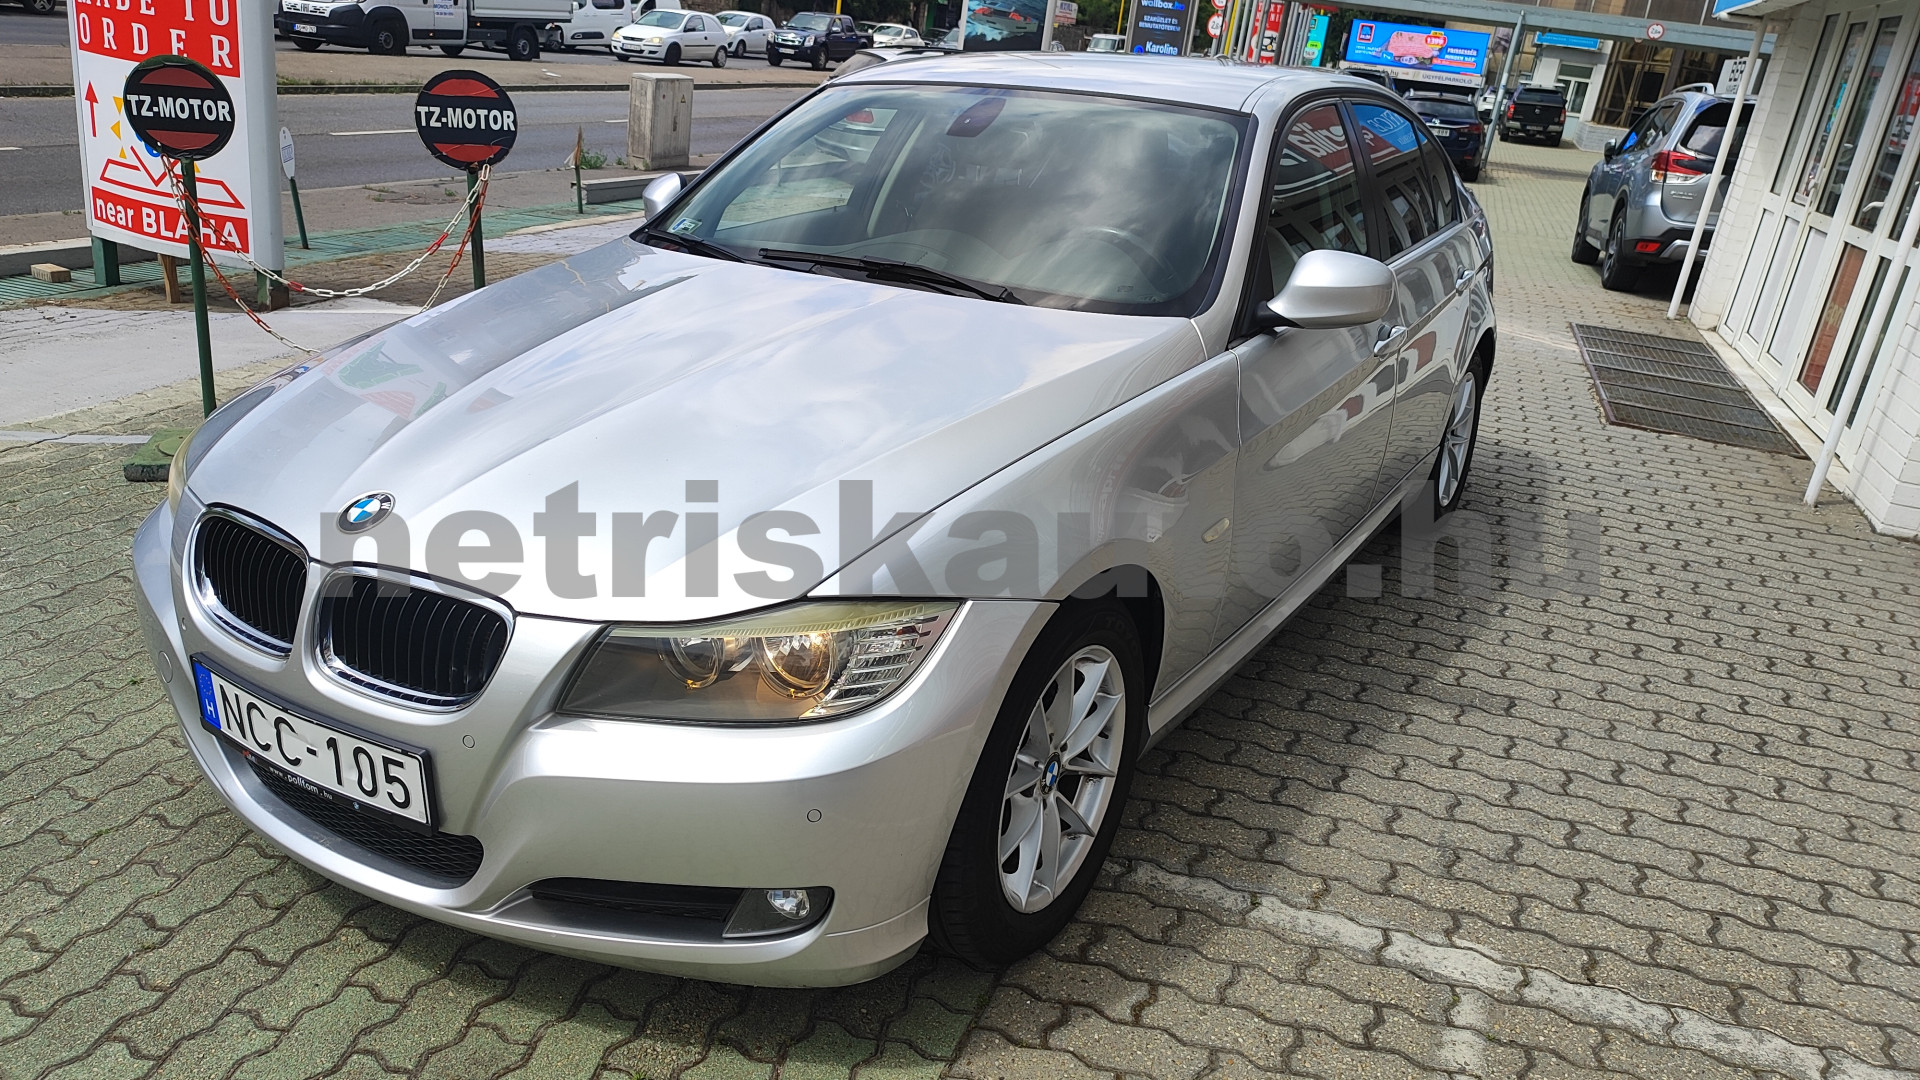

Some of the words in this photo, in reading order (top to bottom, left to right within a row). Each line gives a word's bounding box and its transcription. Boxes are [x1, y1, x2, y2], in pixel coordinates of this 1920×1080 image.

[79, 13, 233, 69] ORDER
[1145, 41, 1178, 56] Karolina
[126, 94, 232, 122] TZ-MOTOR
[416, 105, 516, 131] TZ-MOTOR
[95, 198, 134, 228] near
[204, 698, 216, 719] H
[219, 682, 411, 809] NCC-105
